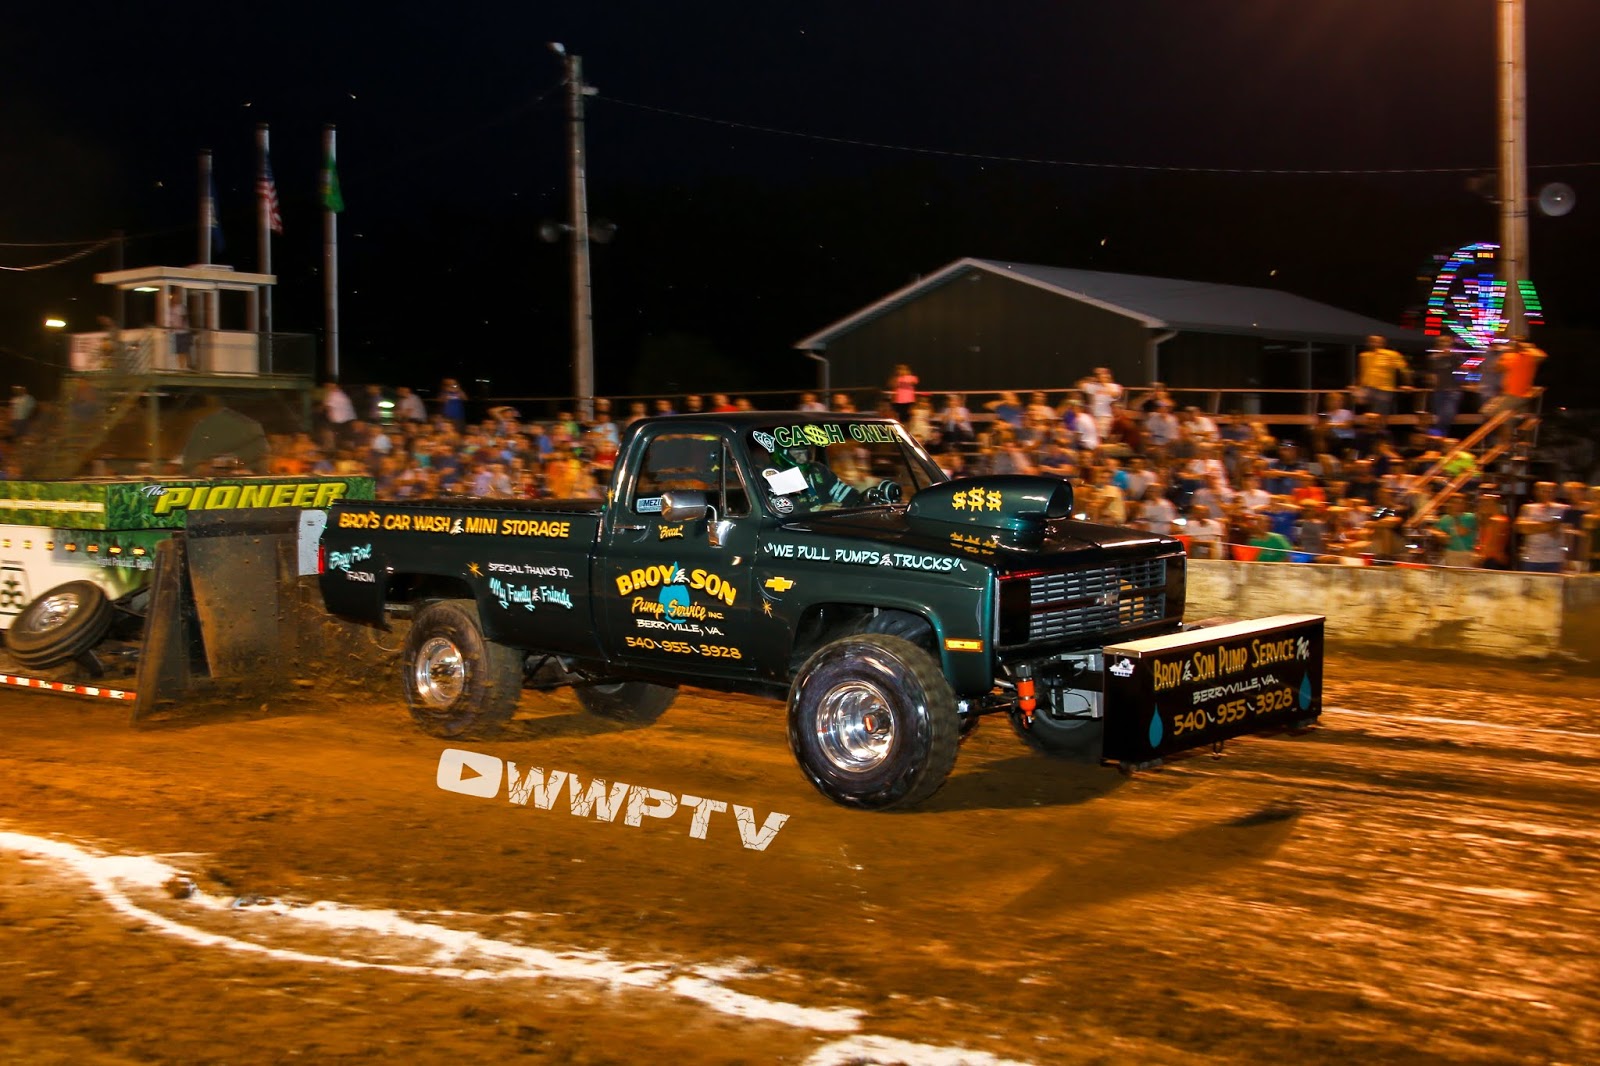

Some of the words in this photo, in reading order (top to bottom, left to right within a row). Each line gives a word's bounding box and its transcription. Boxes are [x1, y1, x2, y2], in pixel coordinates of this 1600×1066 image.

[141, 484, 168, 499] The
[154, 482, 348, 515] PIONEER
[339, 510, 380, 529] BROY'S
[383, 514, 411, 531] CAR
[412, 515, 451, 533] WASH
[449, 518, 465, 536] &
[465, 516, 498, 535] MINI
[501, 519, 571, 538] STORAGE
[797, 544, 831, 561] PULL
[835, 549, 880, 566] PUMPS
[346, 570, 376, 583] FARM
[488, 562, 525, 575] SPECIAL
[524, 564, 557, 577] THANKS
[489, 577, 510, 610] My
[506, 582, 536, 612] Family
[539, 584, 574, 610] Friends
[616, 564, 675, 596] BROY
[689, 569, 737, 606] SON
[631, 596, 665, 620] Pump
[667, 599, 707, 621] Service
[635, 618, 704, 637] BERRYVILLE,
[704, 626, 725, 636] VA.
[1192, 677, 1262, 705] BERRYVILLE,
[1260, 674, 1279, 685] VA.
